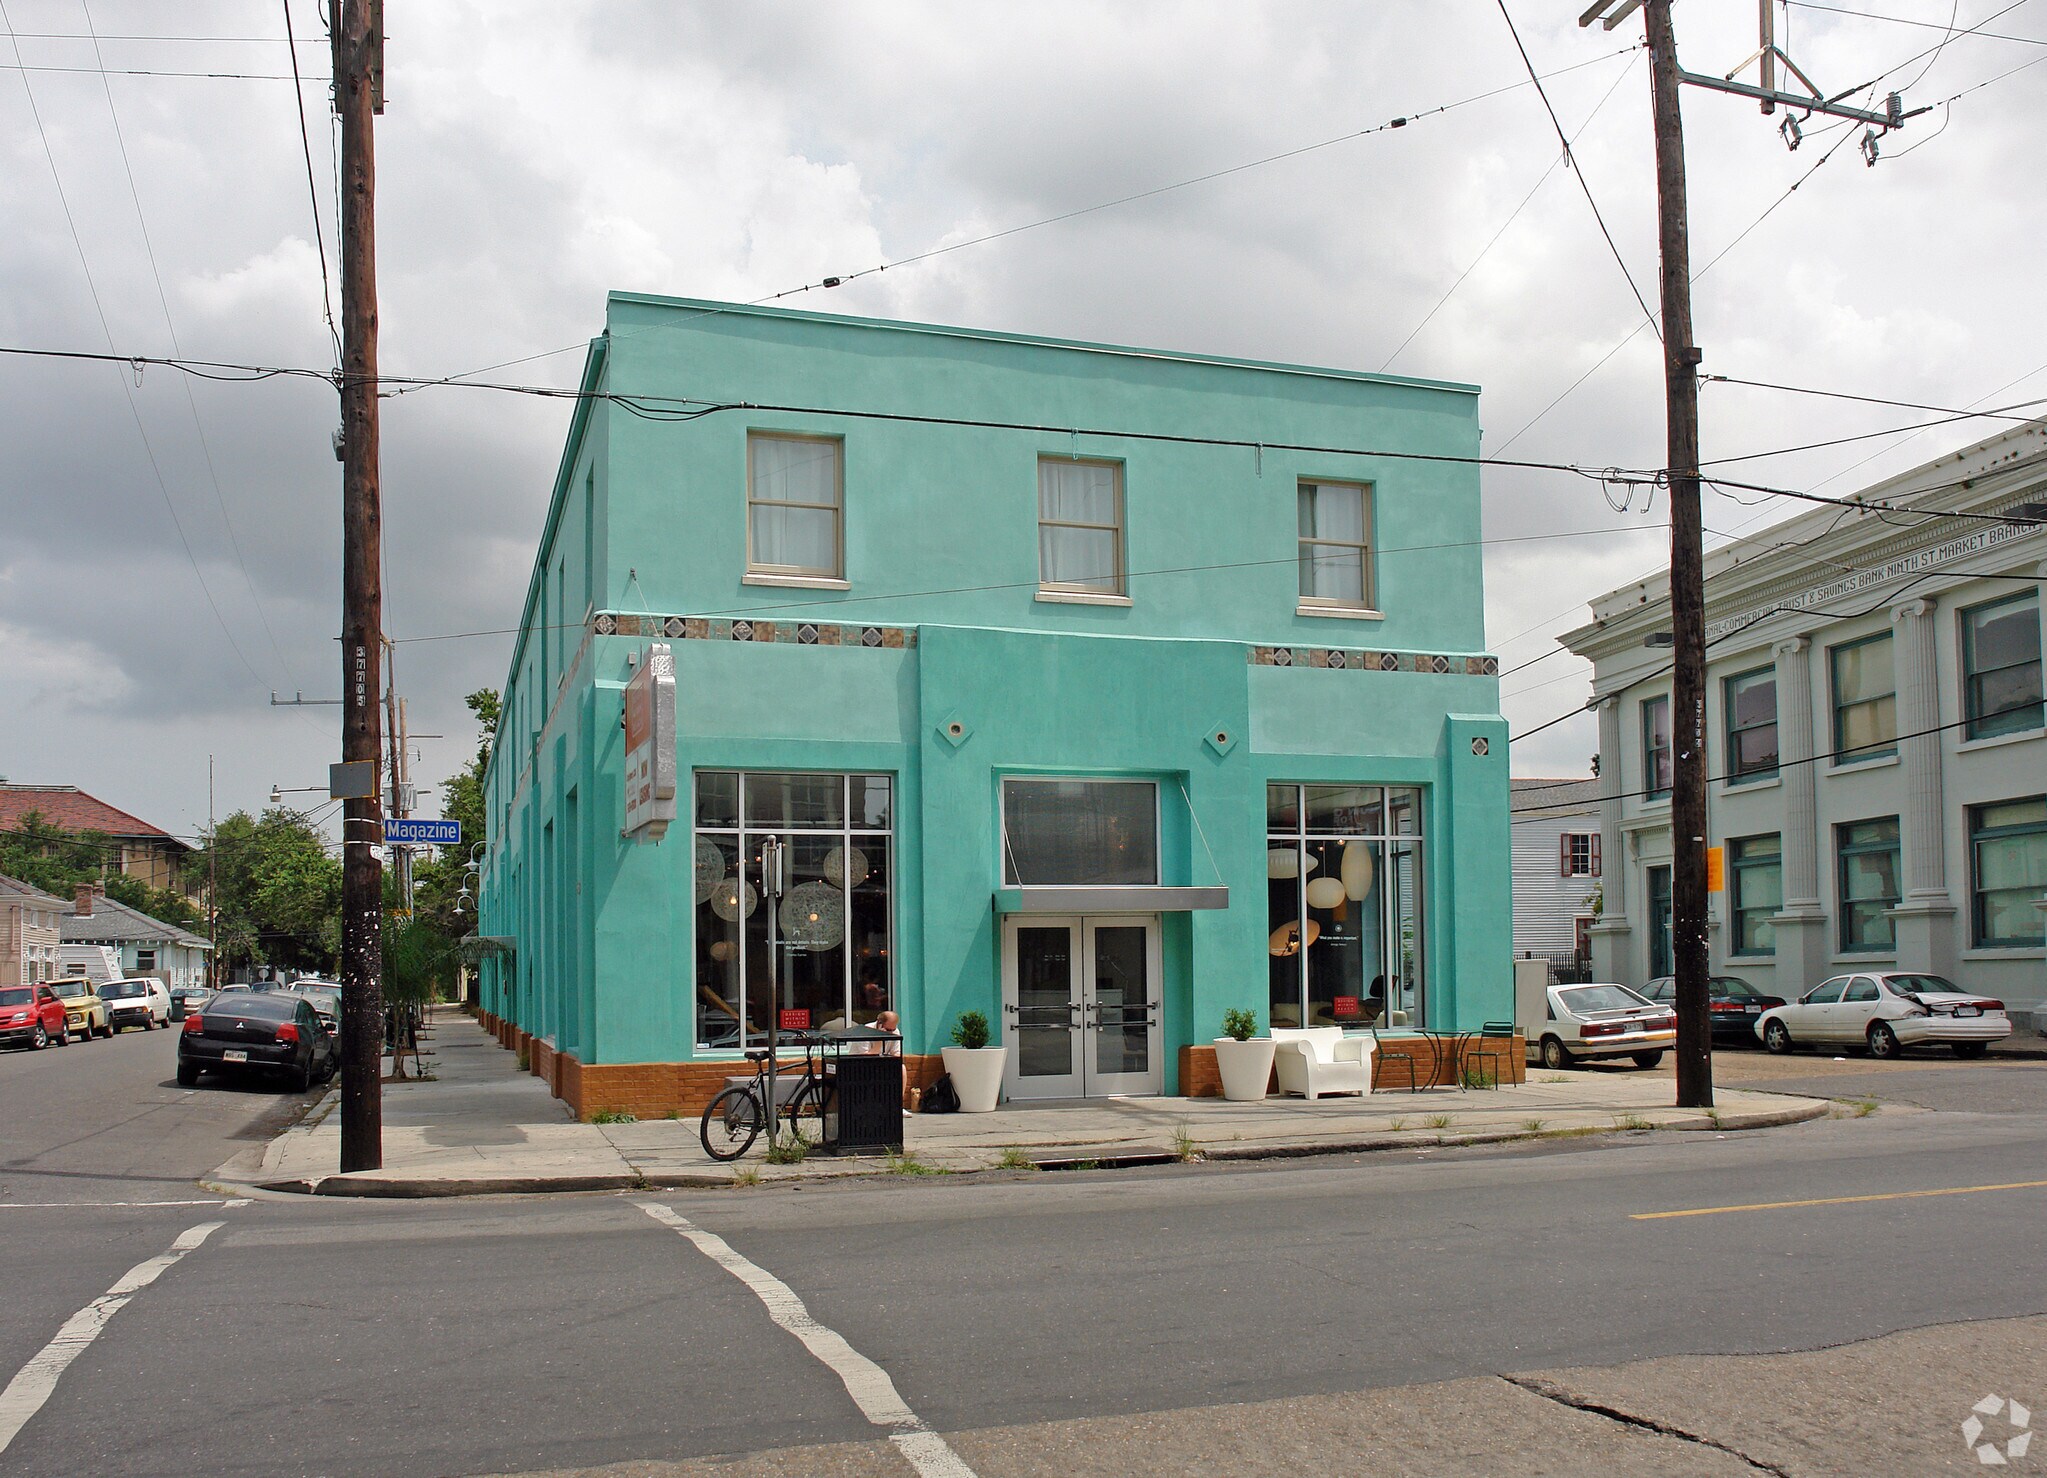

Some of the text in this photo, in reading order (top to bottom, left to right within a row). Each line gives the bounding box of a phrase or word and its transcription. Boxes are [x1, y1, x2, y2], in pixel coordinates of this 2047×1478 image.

[1778, 595, 1806, 612] TRUST
[1809, 592, 1815, 604] &
[1817, 579, 1856, 601] SAVINGS
[1859, 567, 1885, 587] BANK
[1887, 555, 1919, 577] NINTH
[1939, 533, 1985, 561] MARKET
[355, 645, 366, 706] 37705
[387, 821, 456, 842] Magazine
